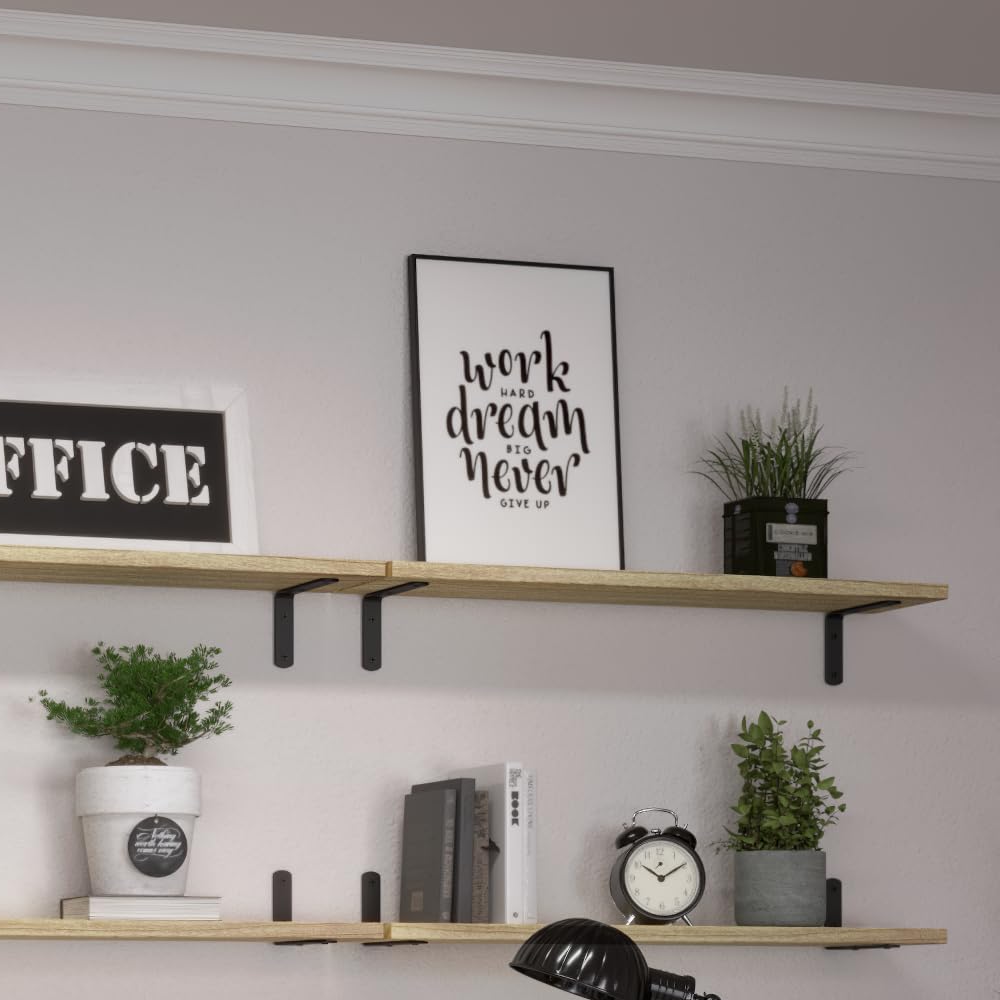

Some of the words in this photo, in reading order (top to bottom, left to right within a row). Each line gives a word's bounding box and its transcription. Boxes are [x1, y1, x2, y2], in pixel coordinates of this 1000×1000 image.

[459, 330, 571, 392] work
[500, 387, 535, 399] HARD
[446, 384, 590, 454] dream
[506, 444, 532, 455] BIG
[500, 498, 529, 509] GIVE
[536, 500, 550, 509] UP
